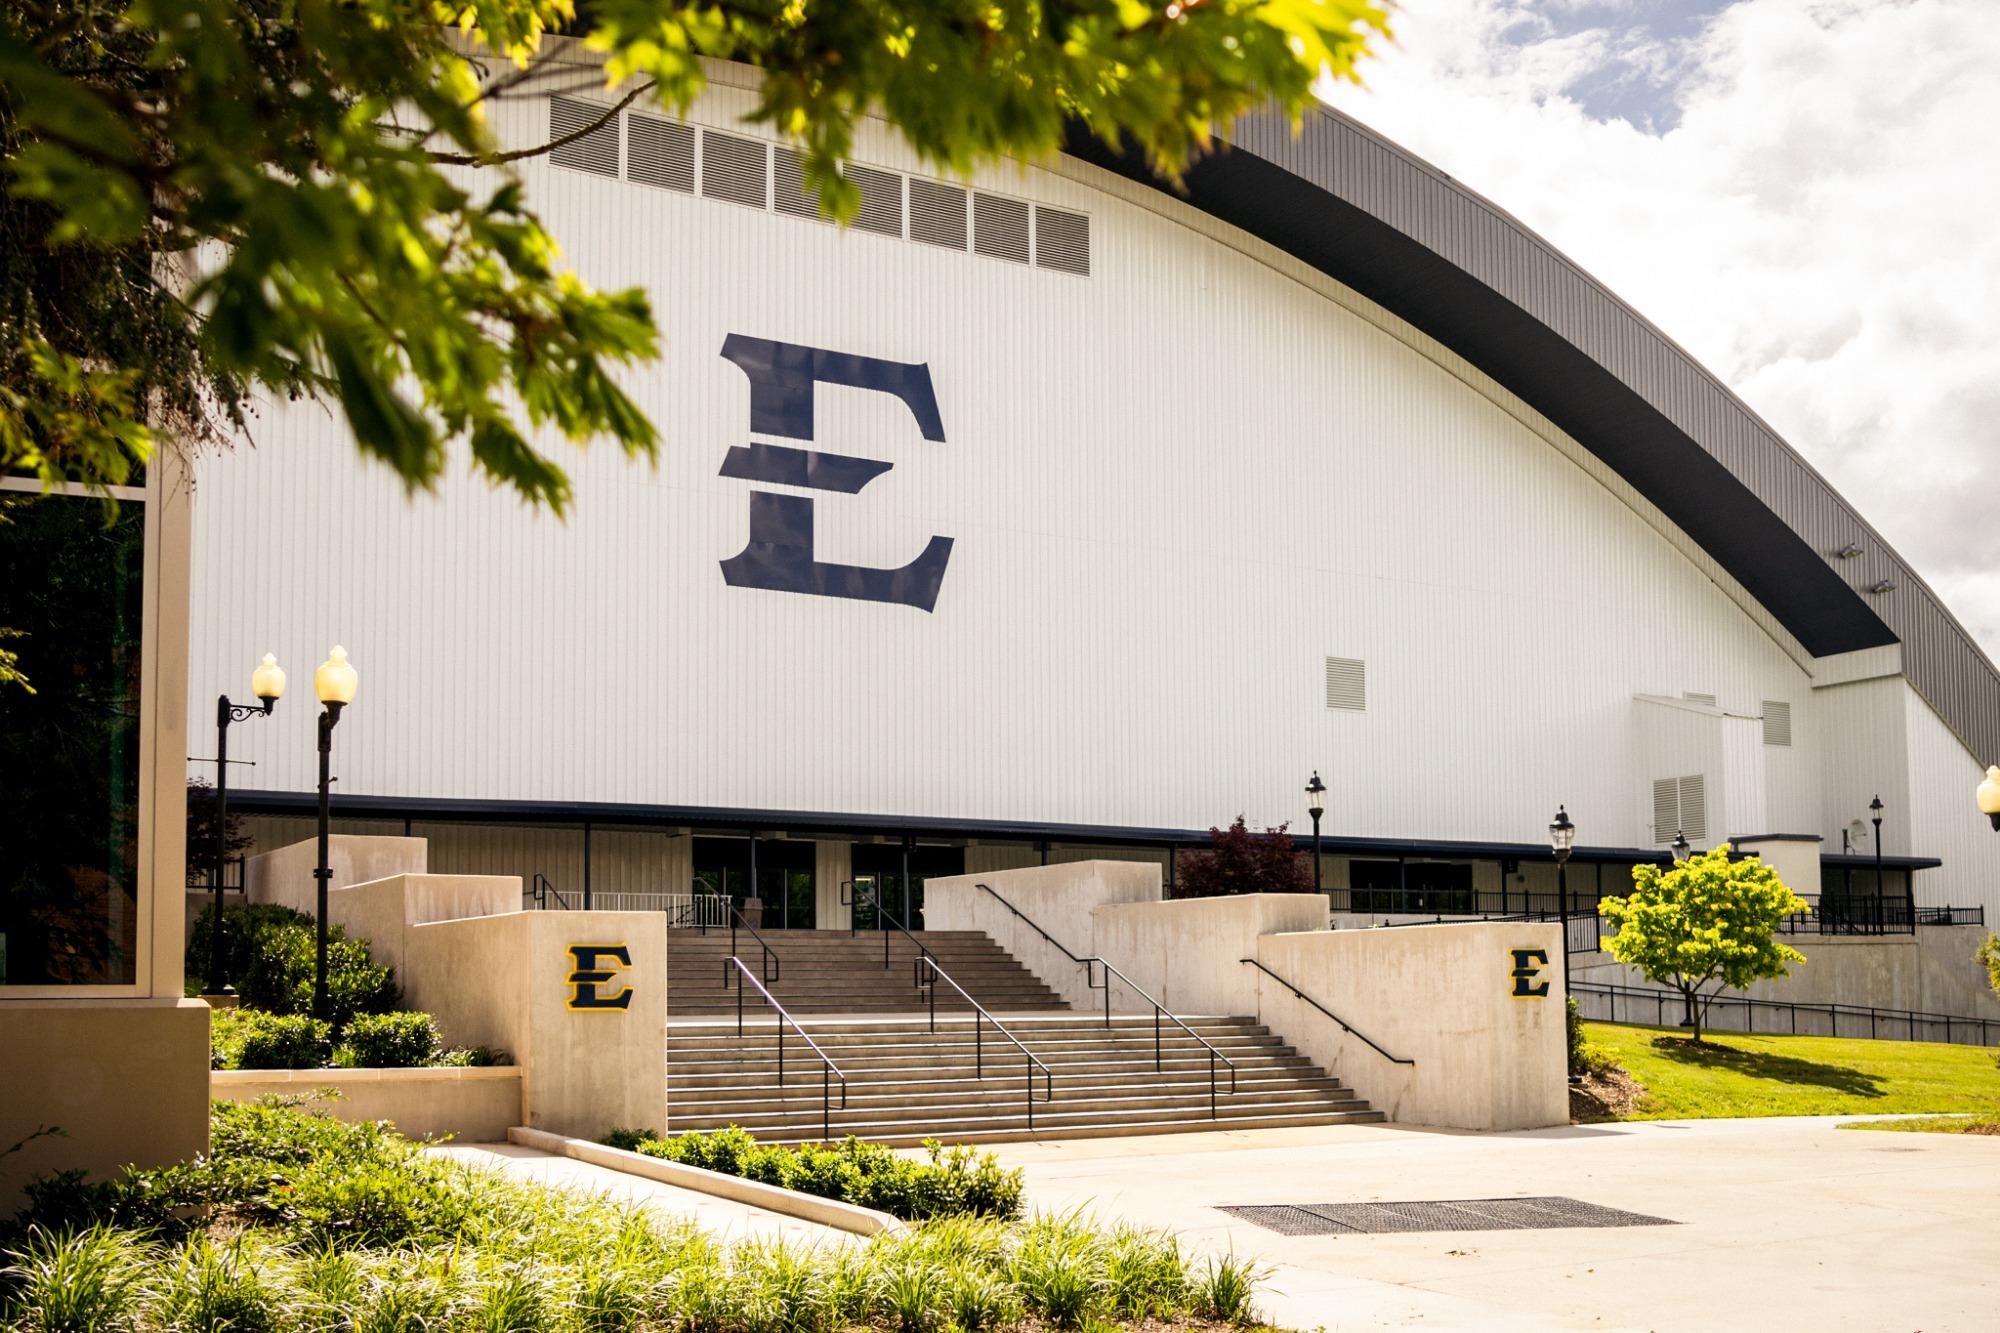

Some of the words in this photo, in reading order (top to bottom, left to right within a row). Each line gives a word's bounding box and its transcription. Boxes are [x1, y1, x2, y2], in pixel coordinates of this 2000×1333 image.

[718, 332, 955, 614] E
[564, 941, 634, 1013] E
[1509, 947, 1550, 1000] E
